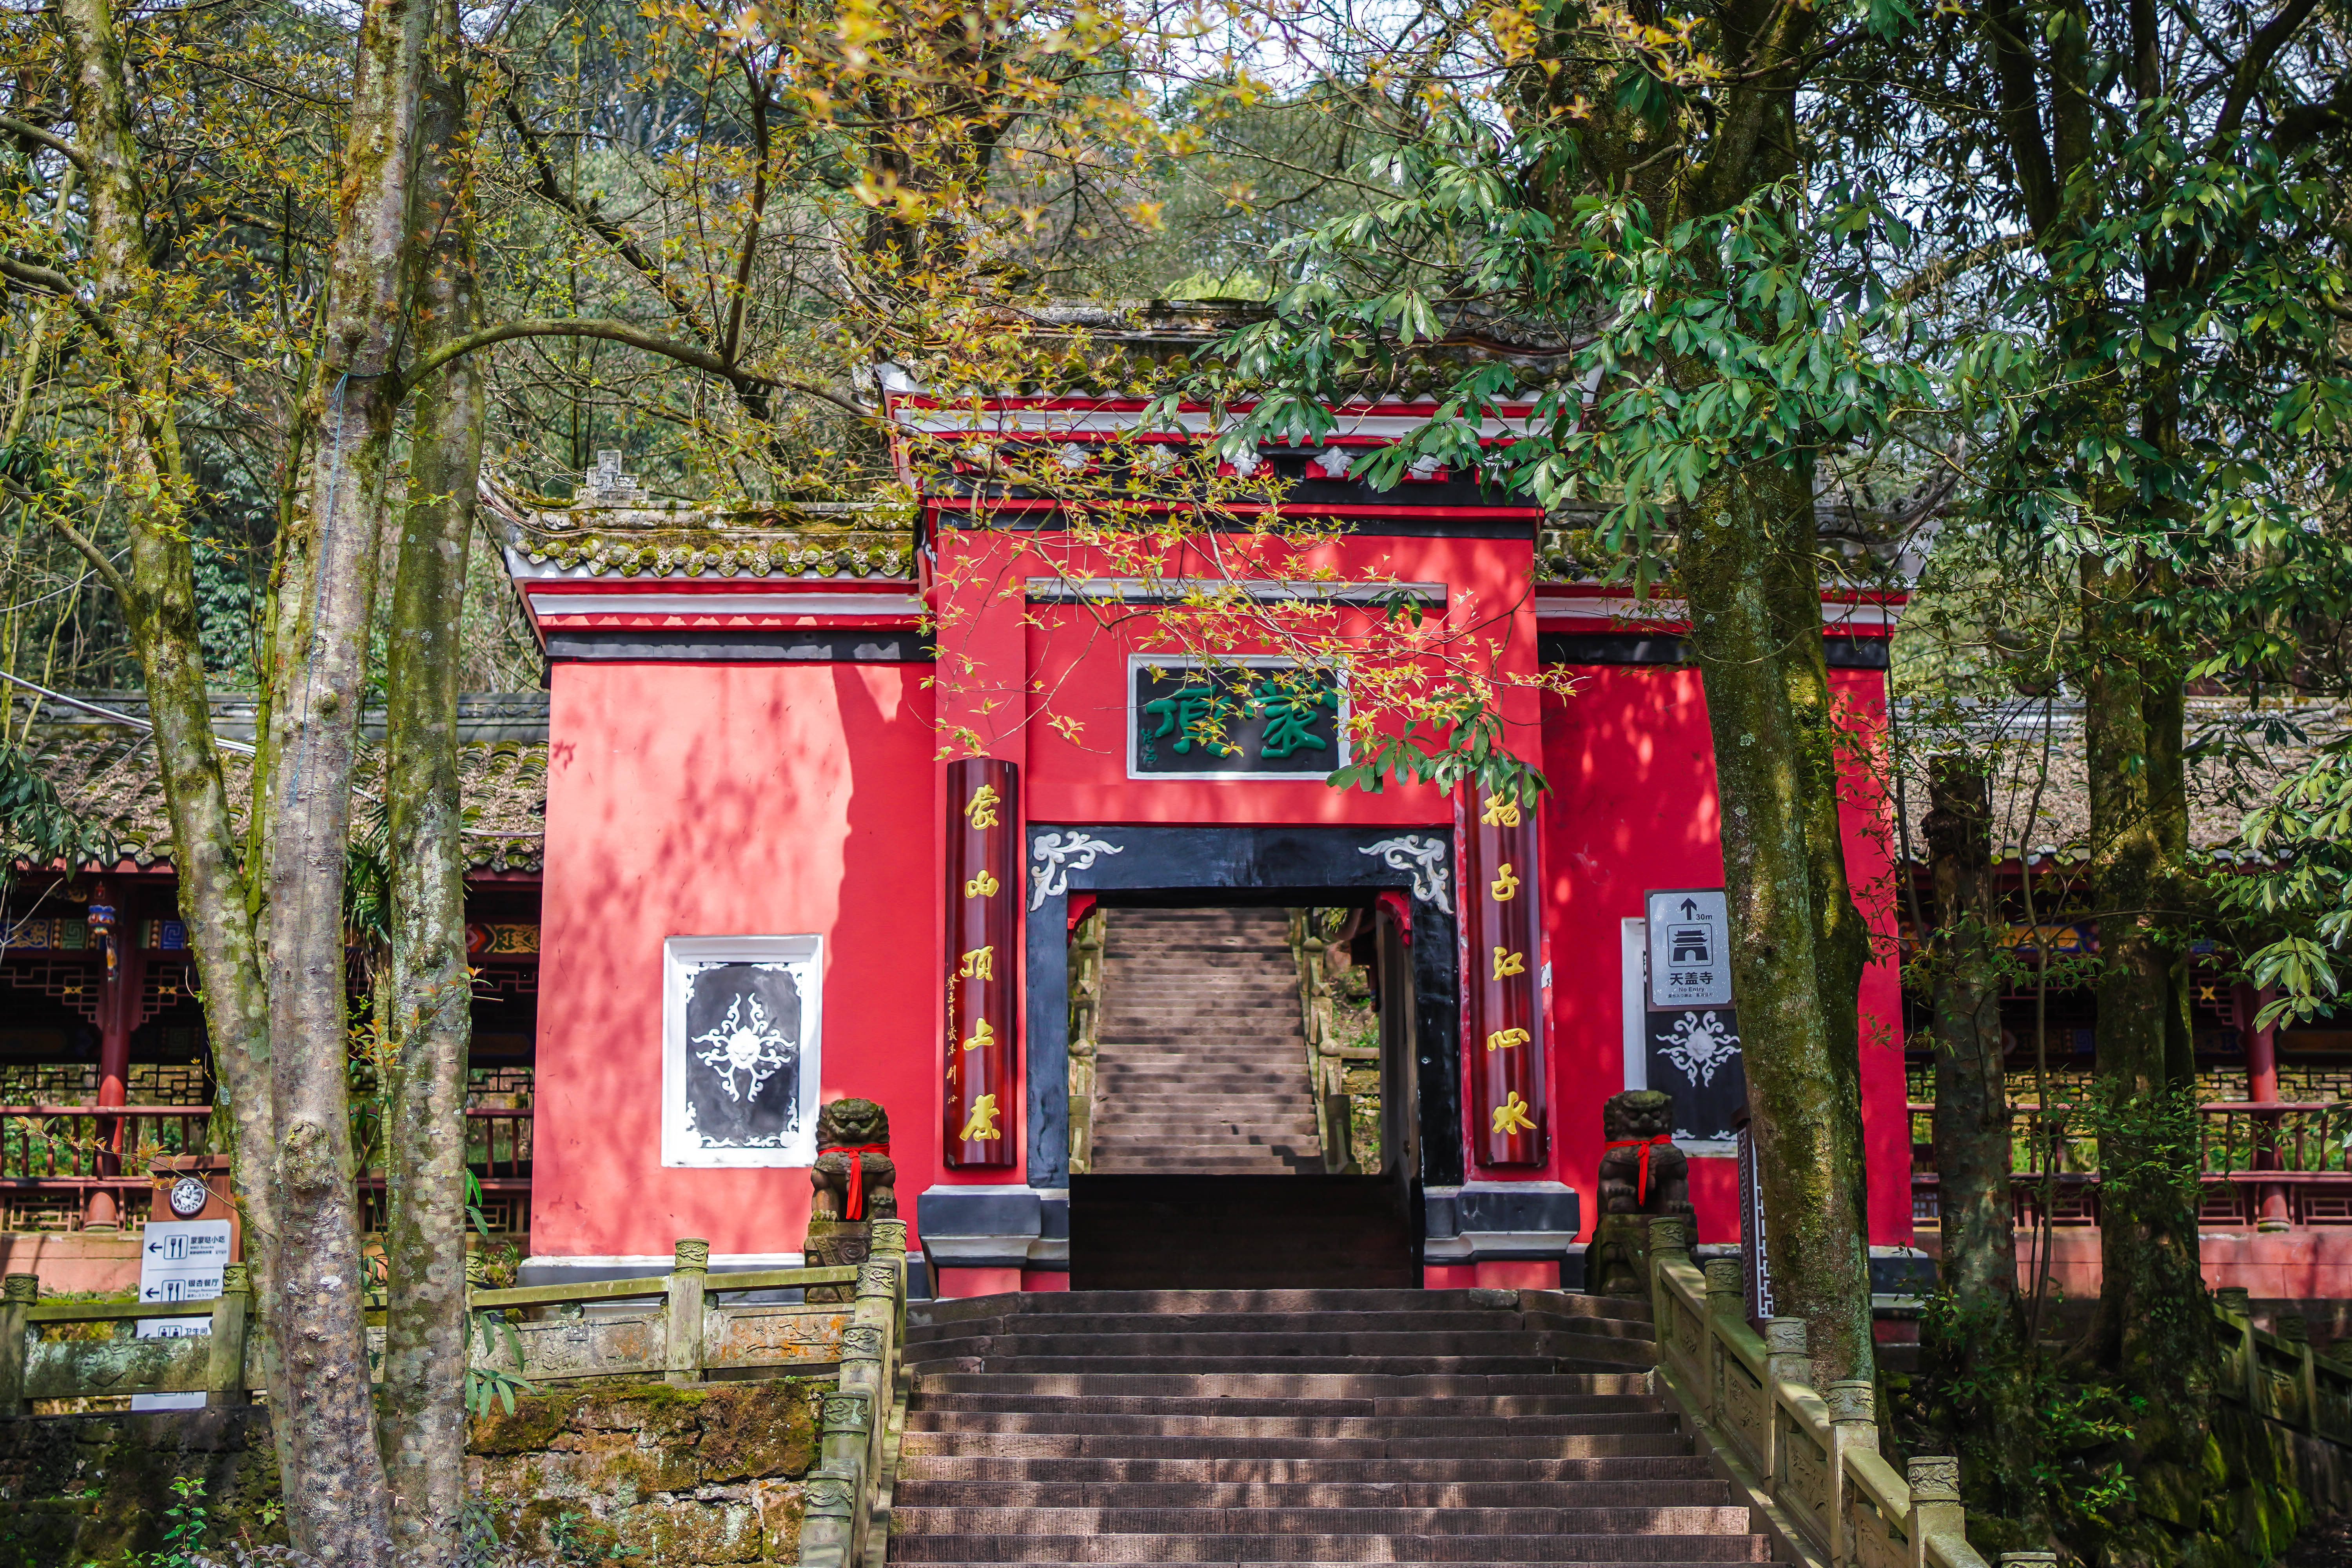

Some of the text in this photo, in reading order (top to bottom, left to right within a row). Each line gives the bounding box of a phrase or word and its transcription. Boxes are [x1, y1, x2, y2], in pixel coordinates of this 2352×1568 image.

[1670, 971, 1713, 985] 天盖寺
[185, 1327, 207, 1336] 卫生间
